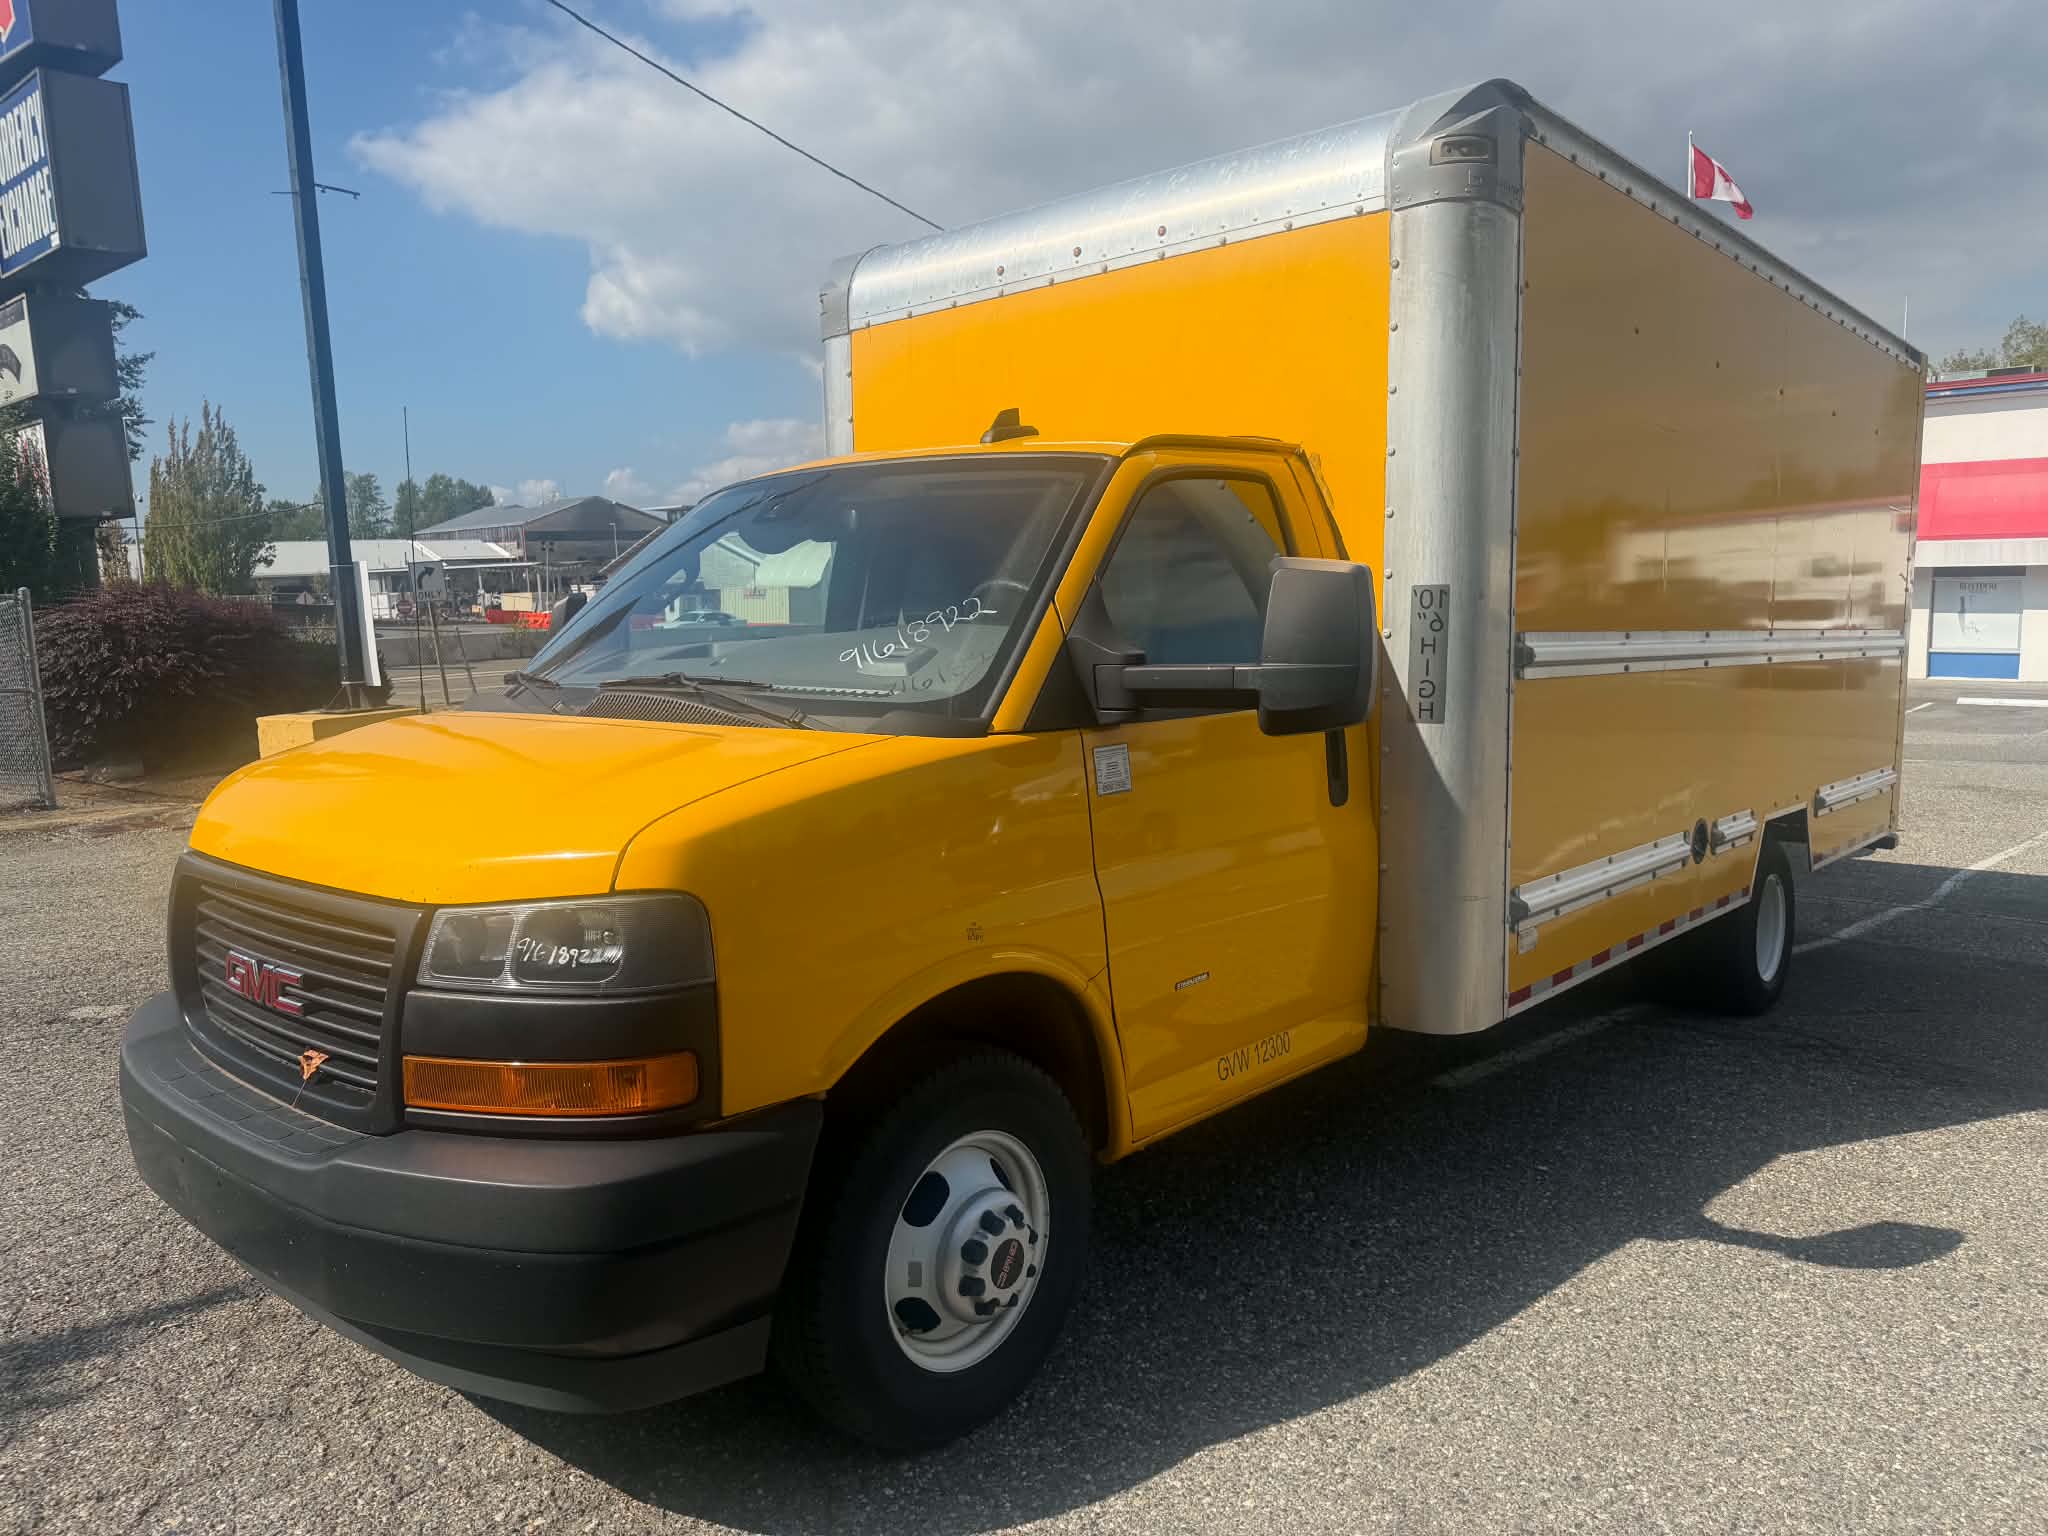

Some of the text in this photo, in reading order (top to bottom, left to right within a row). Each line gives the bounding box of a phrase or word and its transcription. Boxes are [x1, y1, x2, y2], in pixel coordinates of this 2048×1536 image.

[225, 950, 304, 1017] GMC
[1217, 1032, 1290, 1081] GVW 12300
